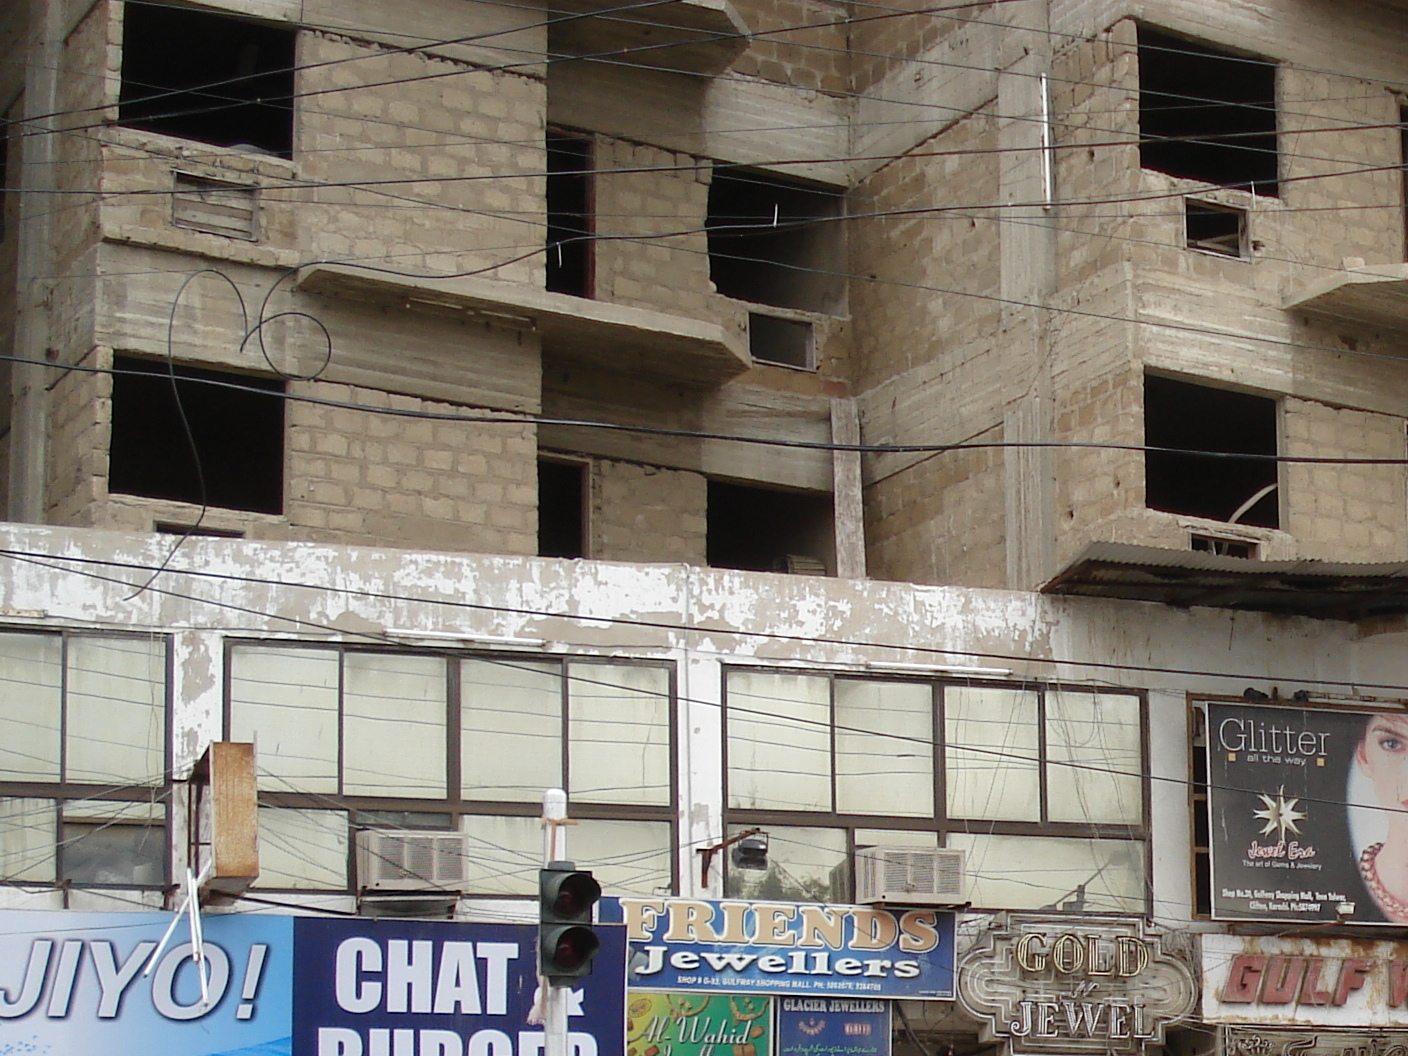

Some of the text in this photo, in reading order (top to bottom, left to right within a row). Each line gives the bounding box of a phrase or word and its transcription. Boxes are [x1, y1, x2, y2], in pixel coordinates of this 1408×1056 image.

[1219, 717, 1330, 755] Glitter
[1246, 752, 1259, 764] all
[1284, 757, 1307, 766] way
[1247, 841, 1286, 859] Jewel
[619, 897, 939, 953] FRIENDS
[634, 945, 921, 978] Jewellers
[1017, 932, 1148, 977] GOLD
[0, 940, 270, 1021] JIYO!
[335, 937, 519, 1016] CHAT
[677, 976, 698, 985] SHOP
[755, 979, 791, 989] SHOPPING
[1220, 953, 1374, 1005] GULF
[783, 999, 885, 1013] GLACIER JEWELLERS
[1010, 1001, 1157, 1039] JEWEL
[629, 1016, 753, 1045] Al-Wahid
